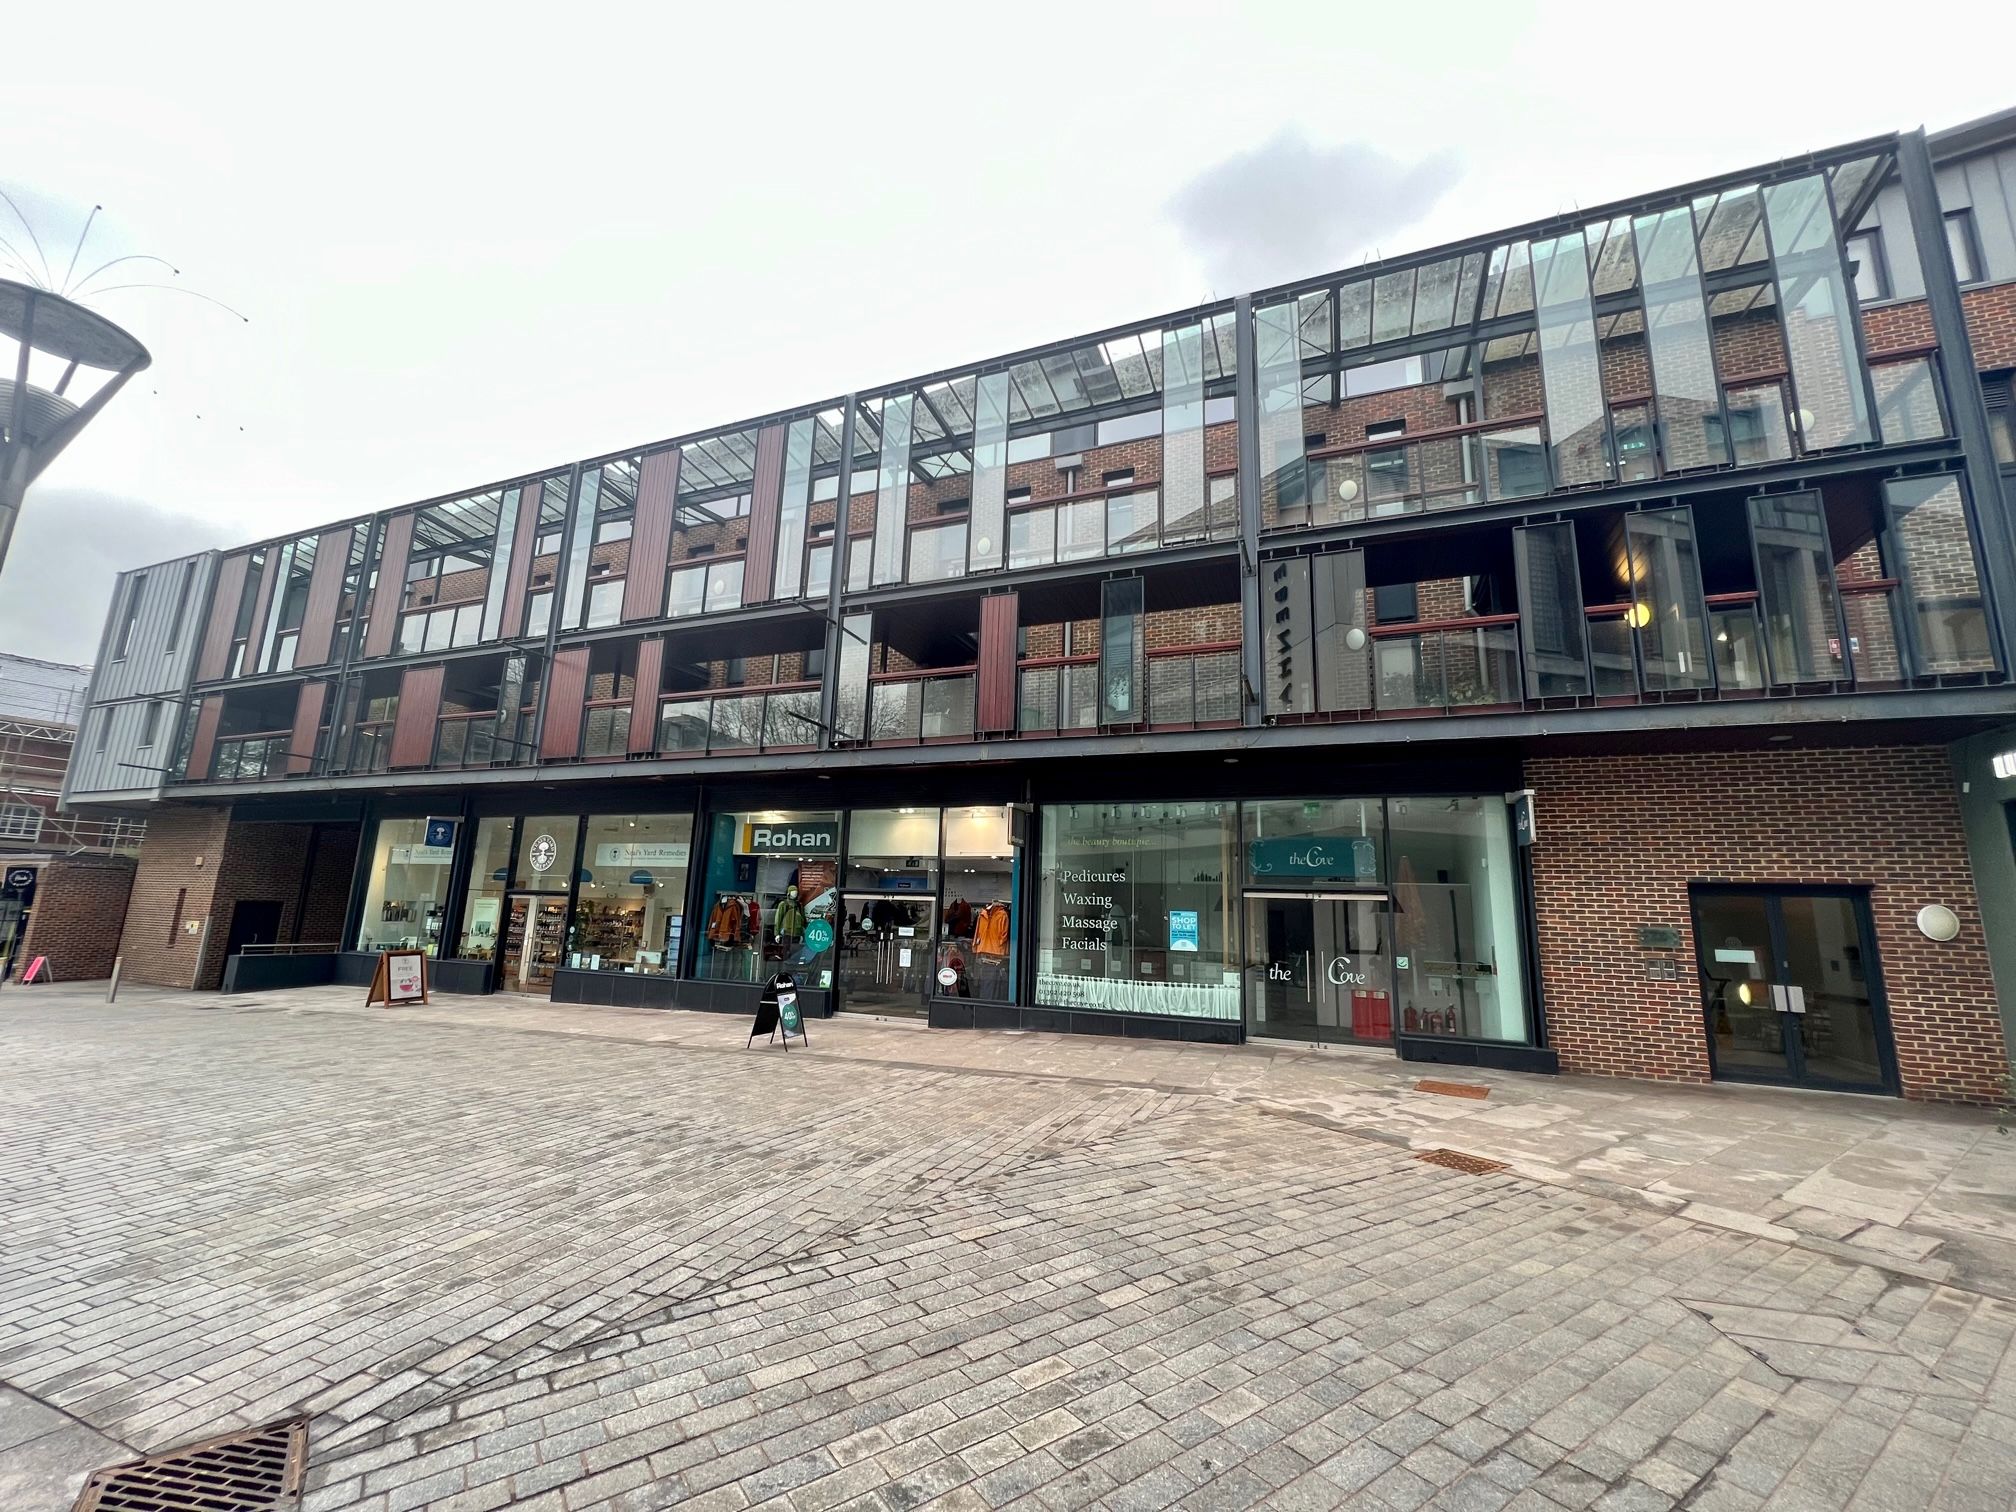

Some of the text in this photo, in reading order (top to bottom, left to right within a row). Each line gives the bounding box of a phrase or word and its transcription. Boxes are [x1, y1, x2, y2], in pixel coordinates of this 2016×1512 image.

[753, 829, 831, 847] Rohan
[625, 848, 687, 857] Neal's Yard Remedies
[1063, 869, 1126, 882] Pedicures
[1063, 893, 1113, 908] Waxing
[1062, 915, 1118, 932] Massage
[1171, 916, 1196, 924] SHOP
[1062, 937, 1107, 951] Facials
[1269, 963, 1292, 980] the
[1328, 956, 1366, 985] Cove
[776, 982, 794, 990] Rohan
